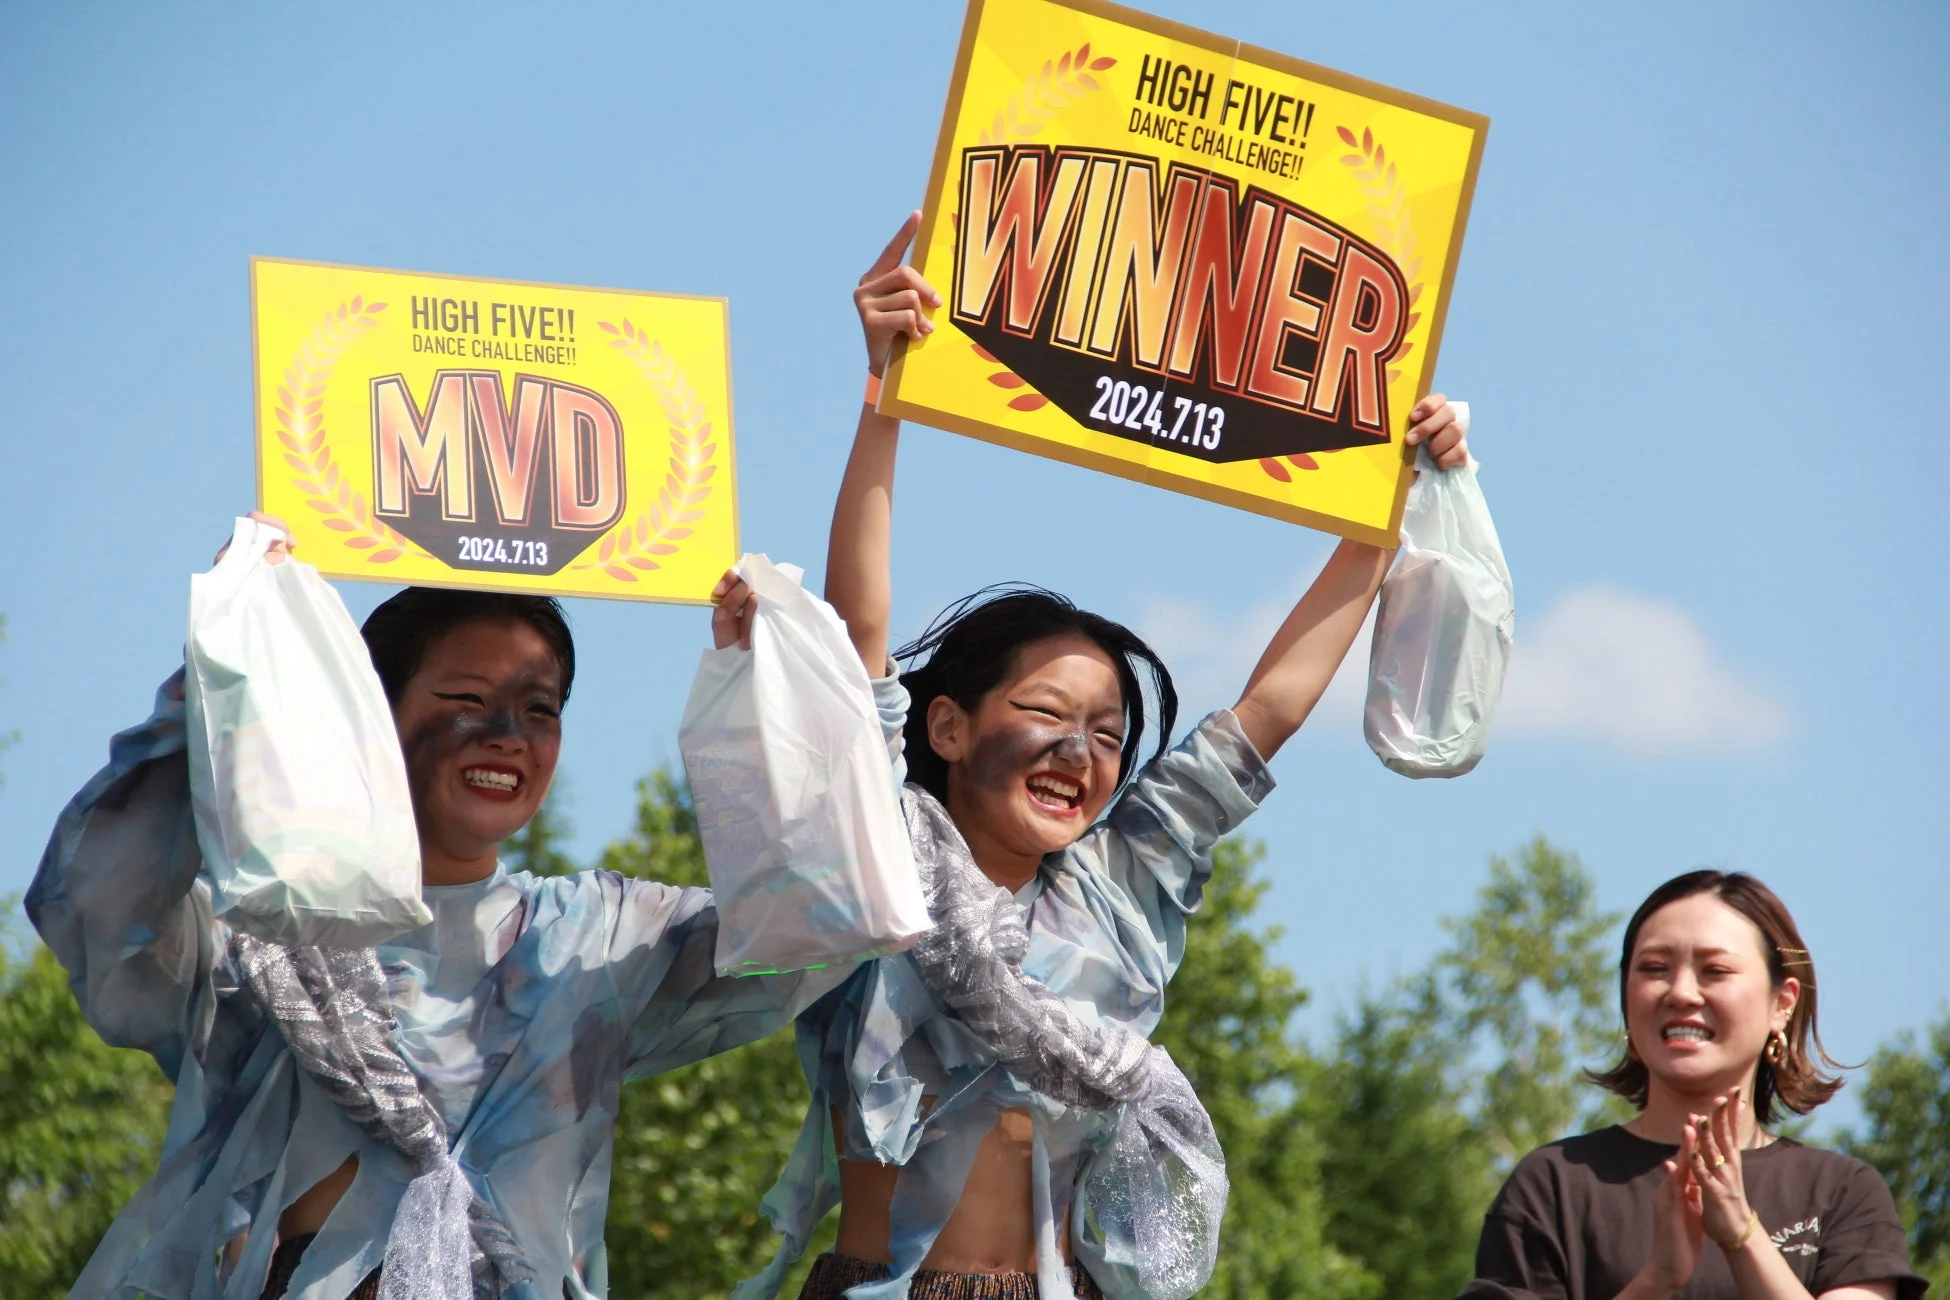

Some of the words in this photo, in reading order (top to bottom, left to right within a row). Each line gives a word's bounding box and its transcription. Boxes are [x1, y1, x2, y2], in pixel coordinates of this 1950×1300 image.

[1135, 53, 1215, 120] HIGH
[1220, 78, 1316, 149] FIVE!!
[1128, 107, 1188, 147] DANCE
[1191, 125, 1304, 181] CHALLENGE!!
[411, 295, 479, 335] HIGH
[491, 302, 575, 342] FIVE!!
[952, 144, 1410, 437] WINNER
[412, 334, 466, 356] DANCE
[471, 339, 577, 366] CHALLENGE!!
[369, 368, 627, 531] MVD
[1089, 375, 1225, 450] 2024.7.13
[458, 536, 548, 566] 2024.7.13
